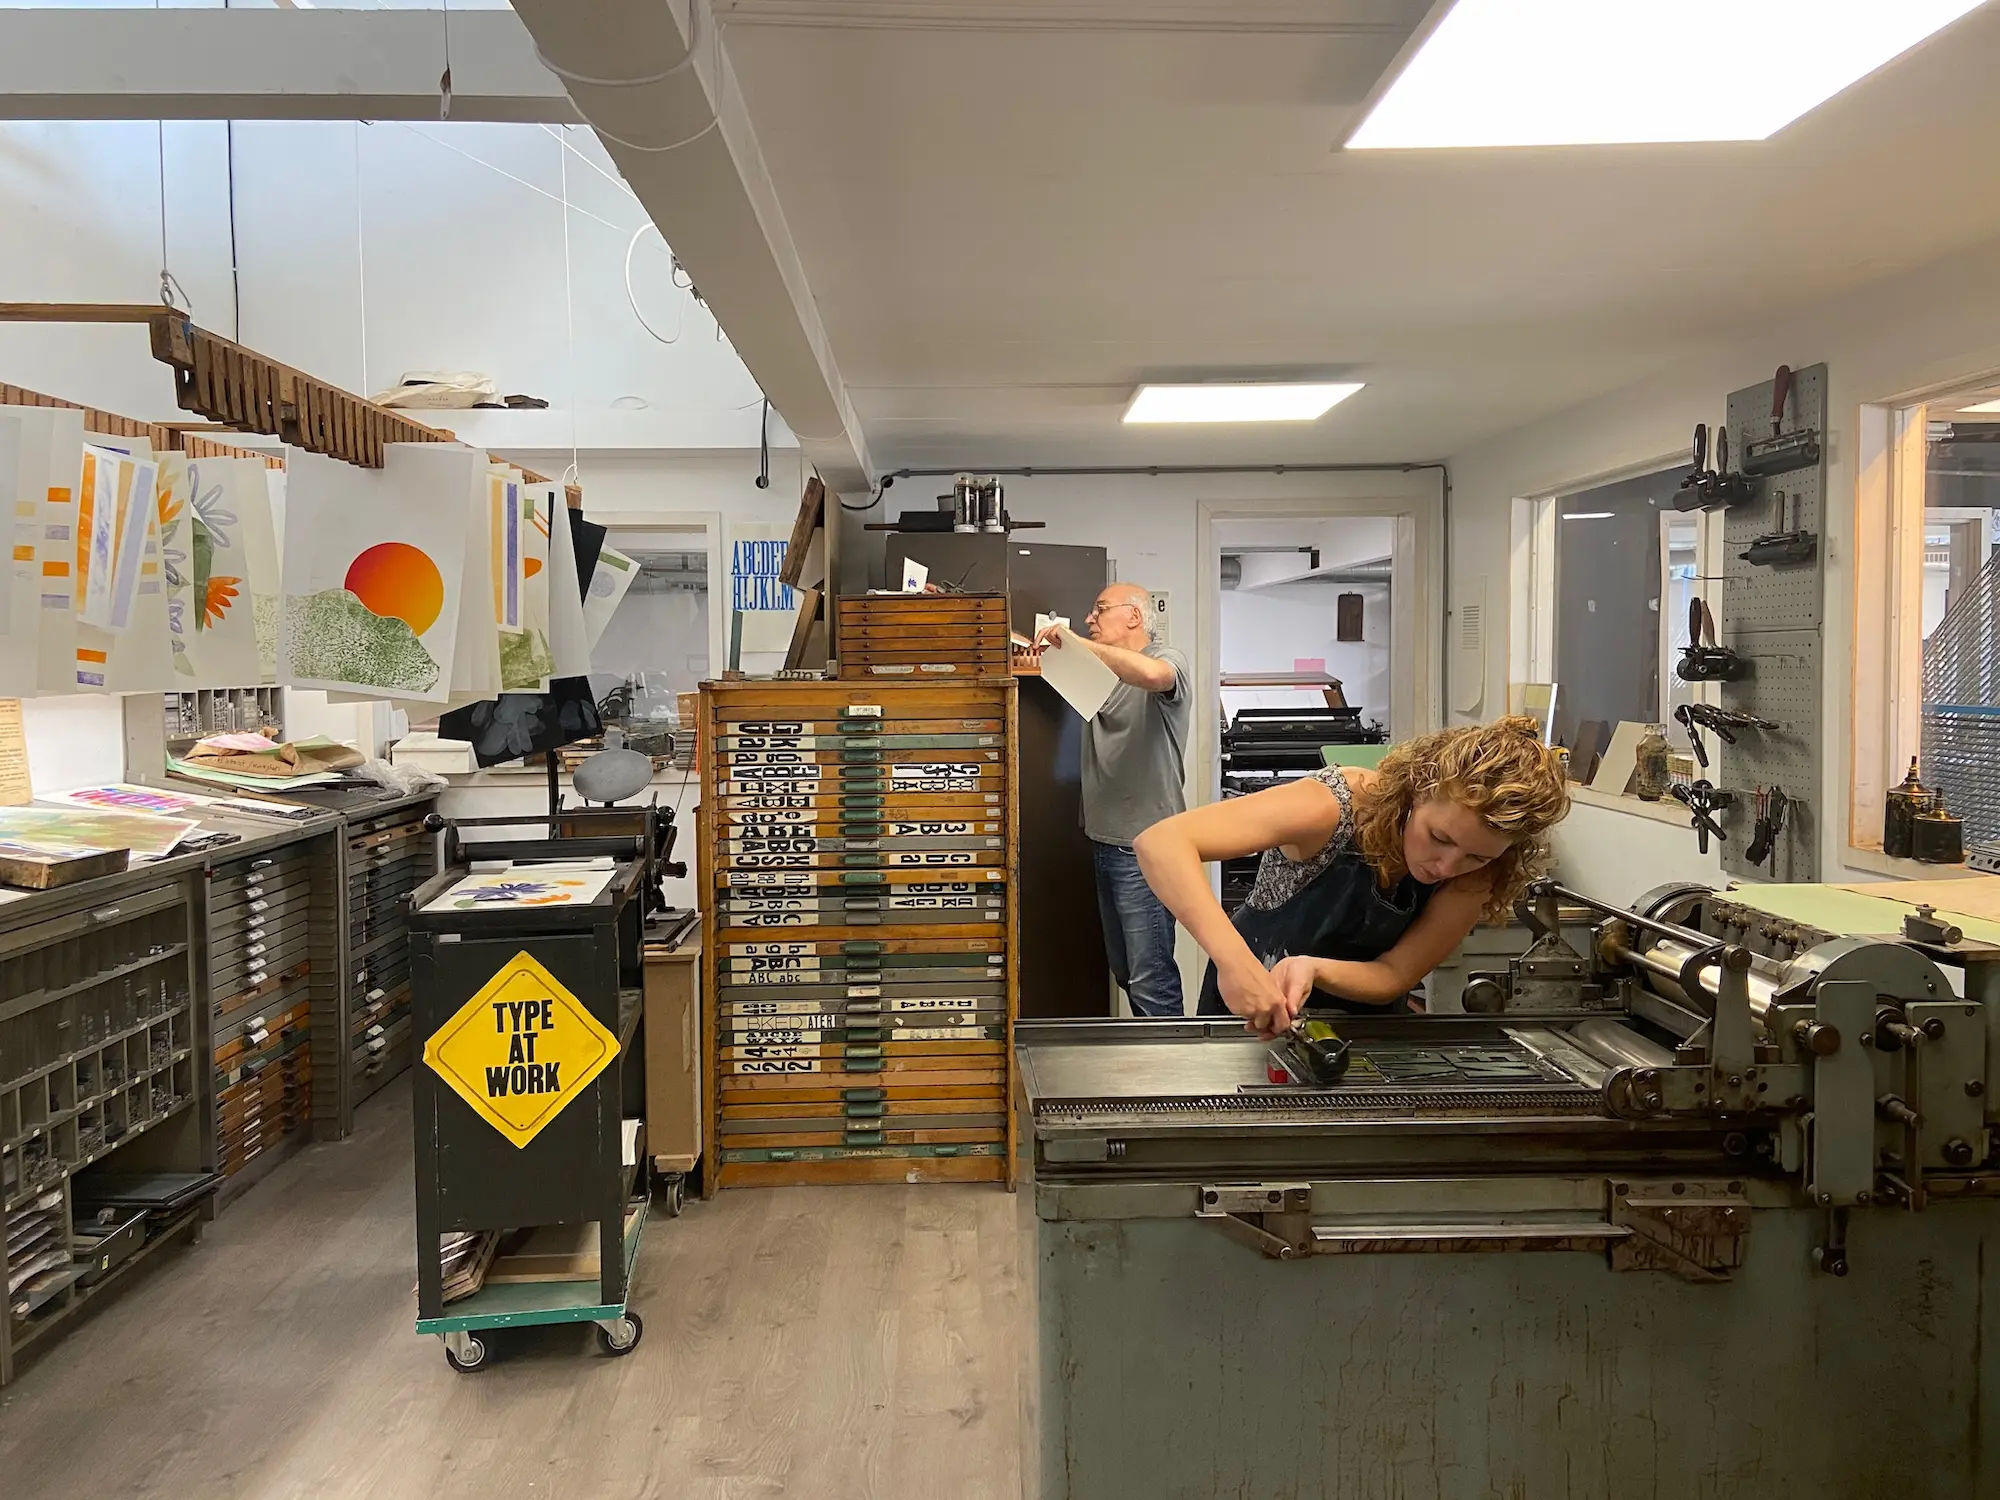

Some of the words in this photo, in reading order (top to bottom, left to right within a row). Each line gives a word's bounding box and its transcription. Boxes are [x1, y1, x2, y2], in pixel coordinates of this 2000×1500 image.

[732, 576, 795, 610] HIJKLM
[492, 999, 554, 1034] TYPE
[509, 1032, 538, 1065] AT
[485, 1062, 561, 1098] WORK
